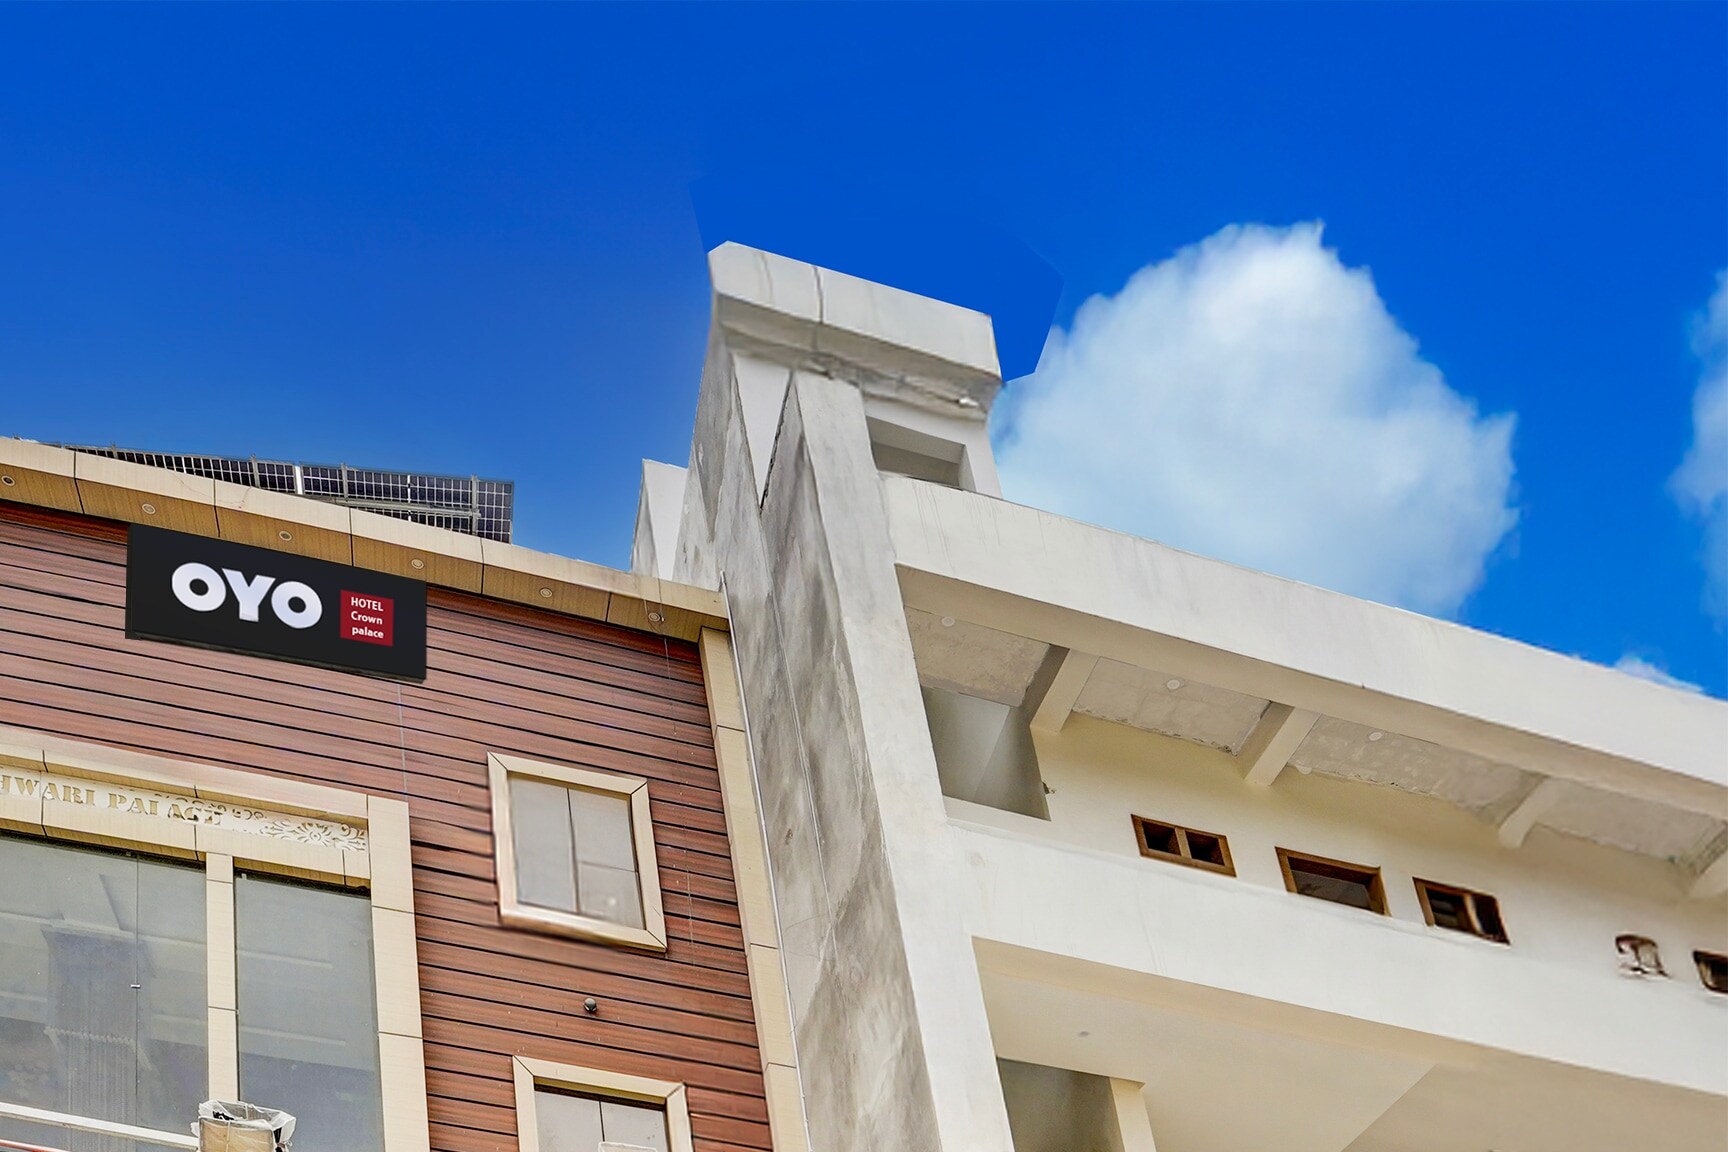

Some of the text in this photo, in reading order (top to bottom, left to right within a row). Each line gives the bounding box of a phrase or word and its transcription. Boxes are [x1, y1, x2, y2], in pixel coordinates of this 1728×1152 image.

[172, 562, 322, 629] OYO
[351, 597, 384, 612] HOTEL
[351, 610, 383, 625] Crown
[352, 626, 384, 638] palace
